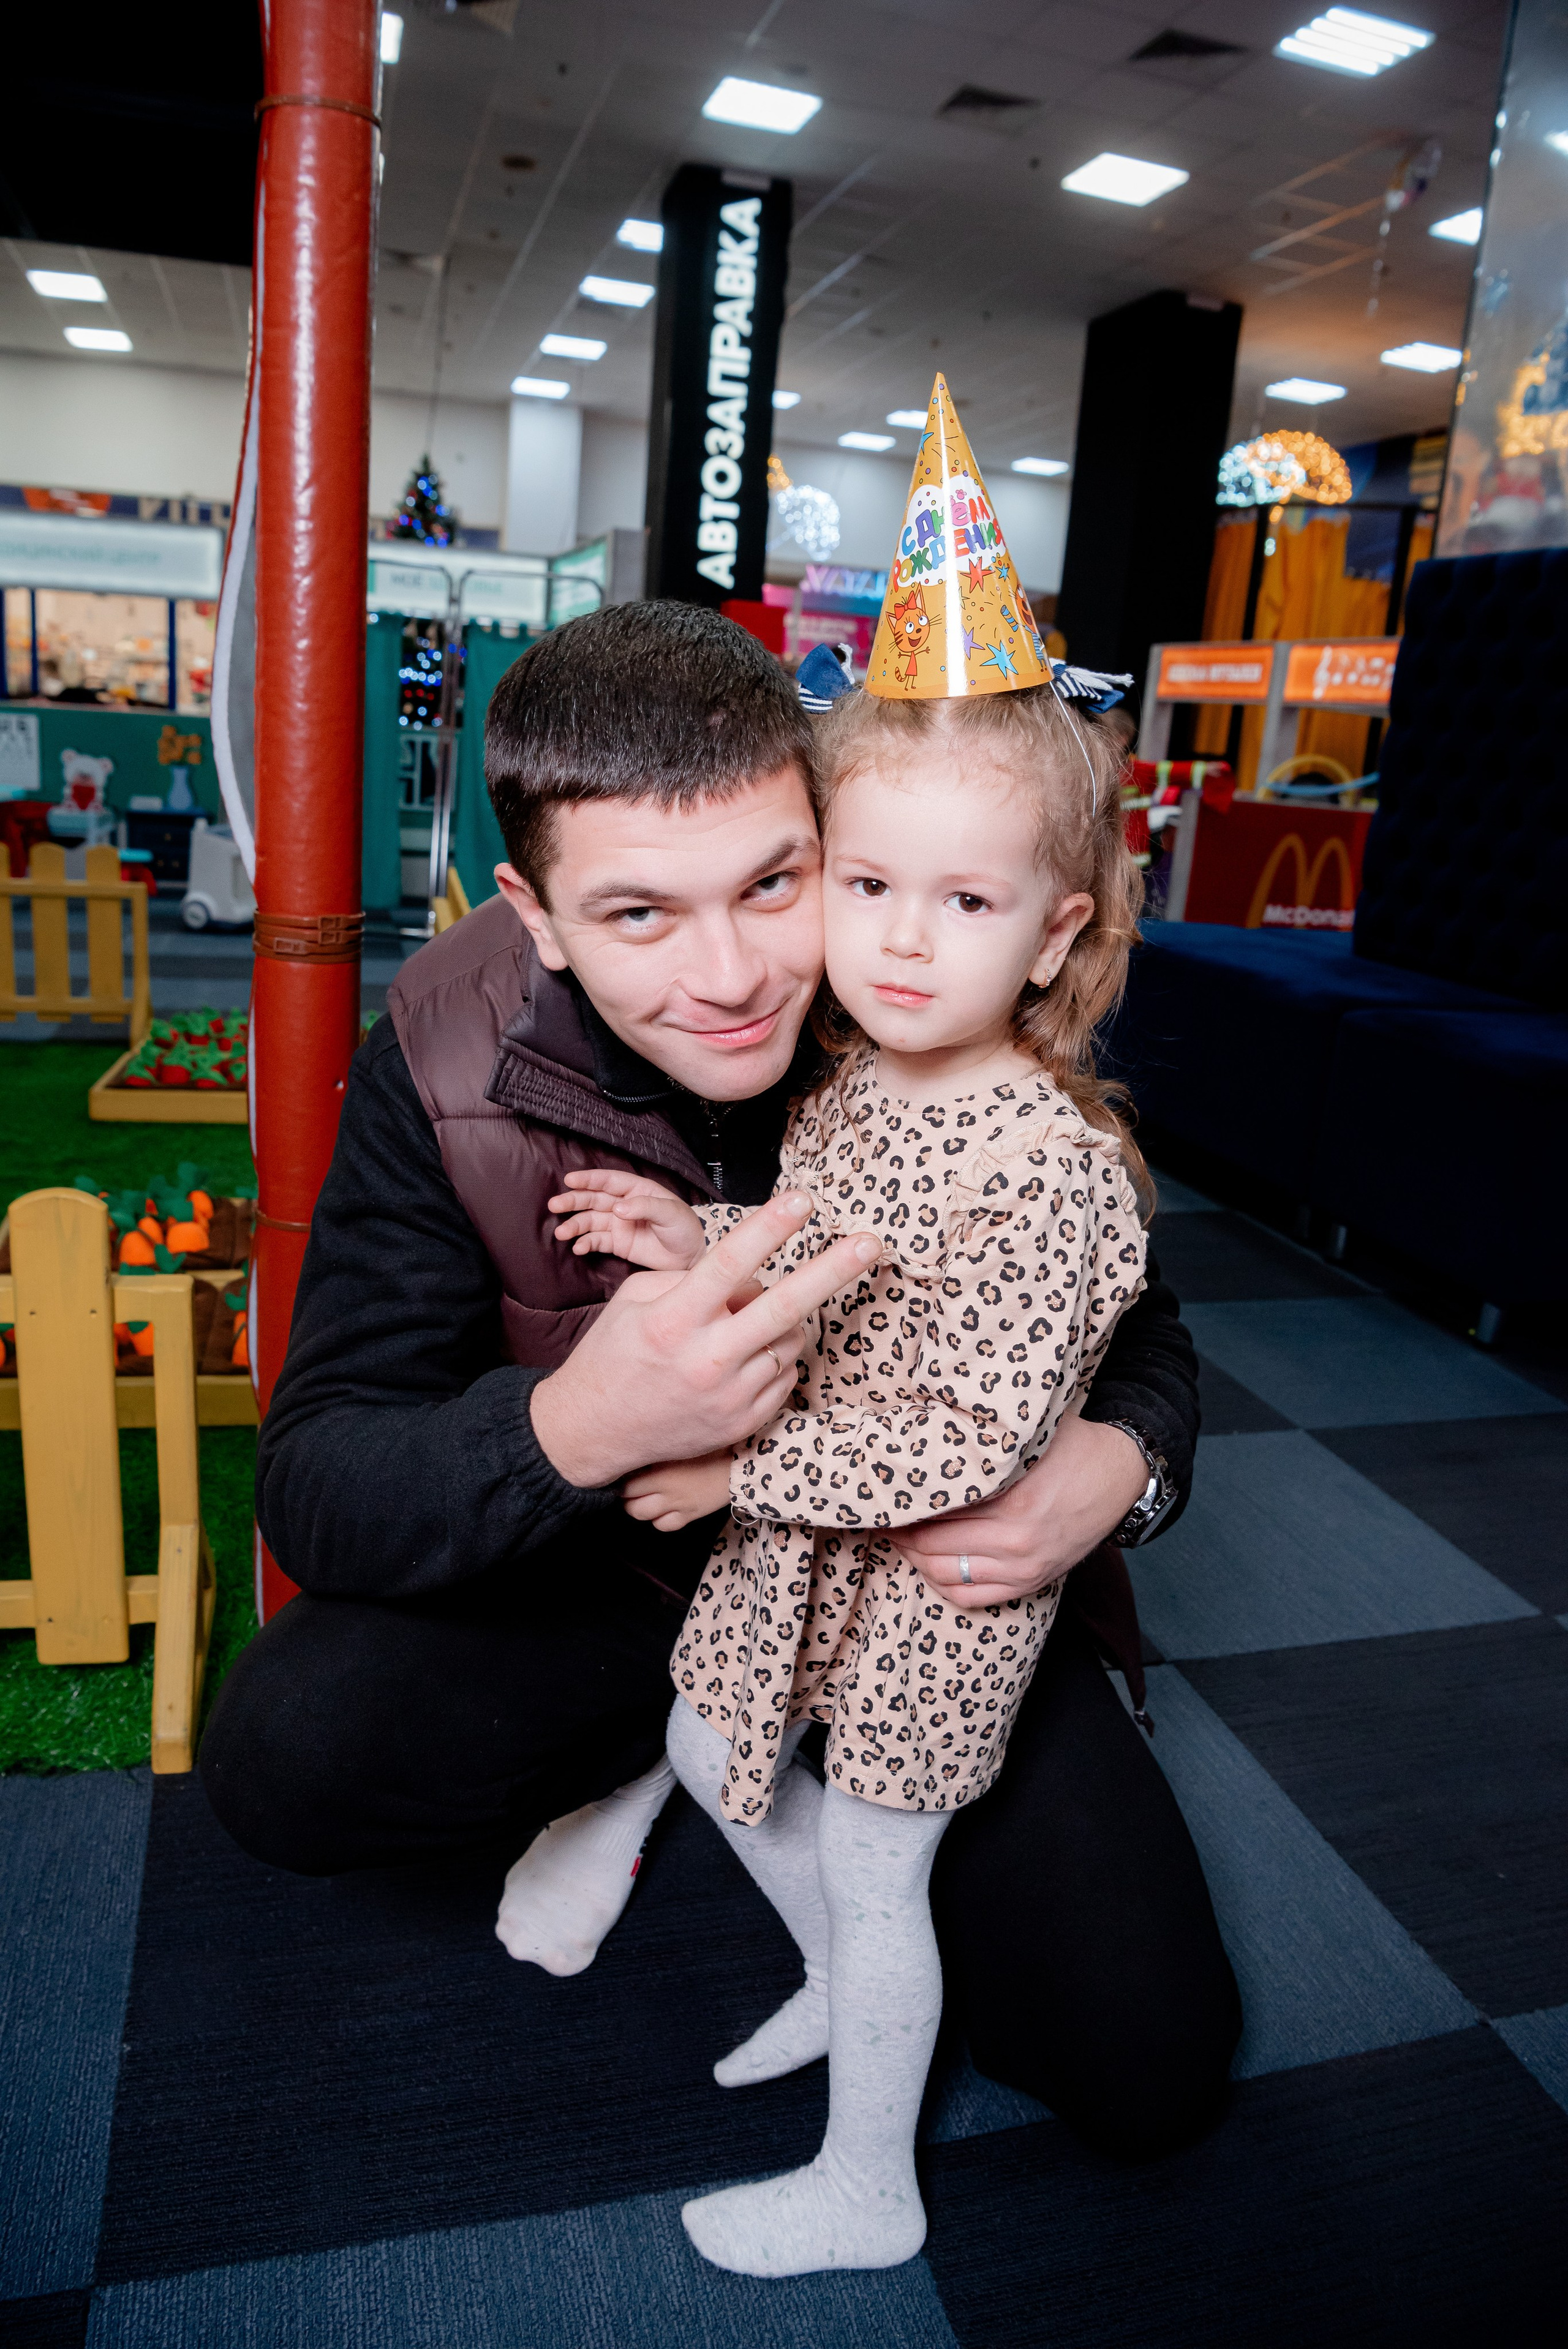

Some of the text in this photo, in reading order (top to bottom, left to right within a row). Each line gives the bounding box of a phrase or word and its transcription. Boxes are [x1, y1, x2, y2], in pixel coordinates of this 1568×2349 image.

[696, 197, 763, 590] АВТОЗАПРАВКА
[892, 518, 1006, 593] РОЖДЕНИЯ
[902, 526, 916, 556] С
